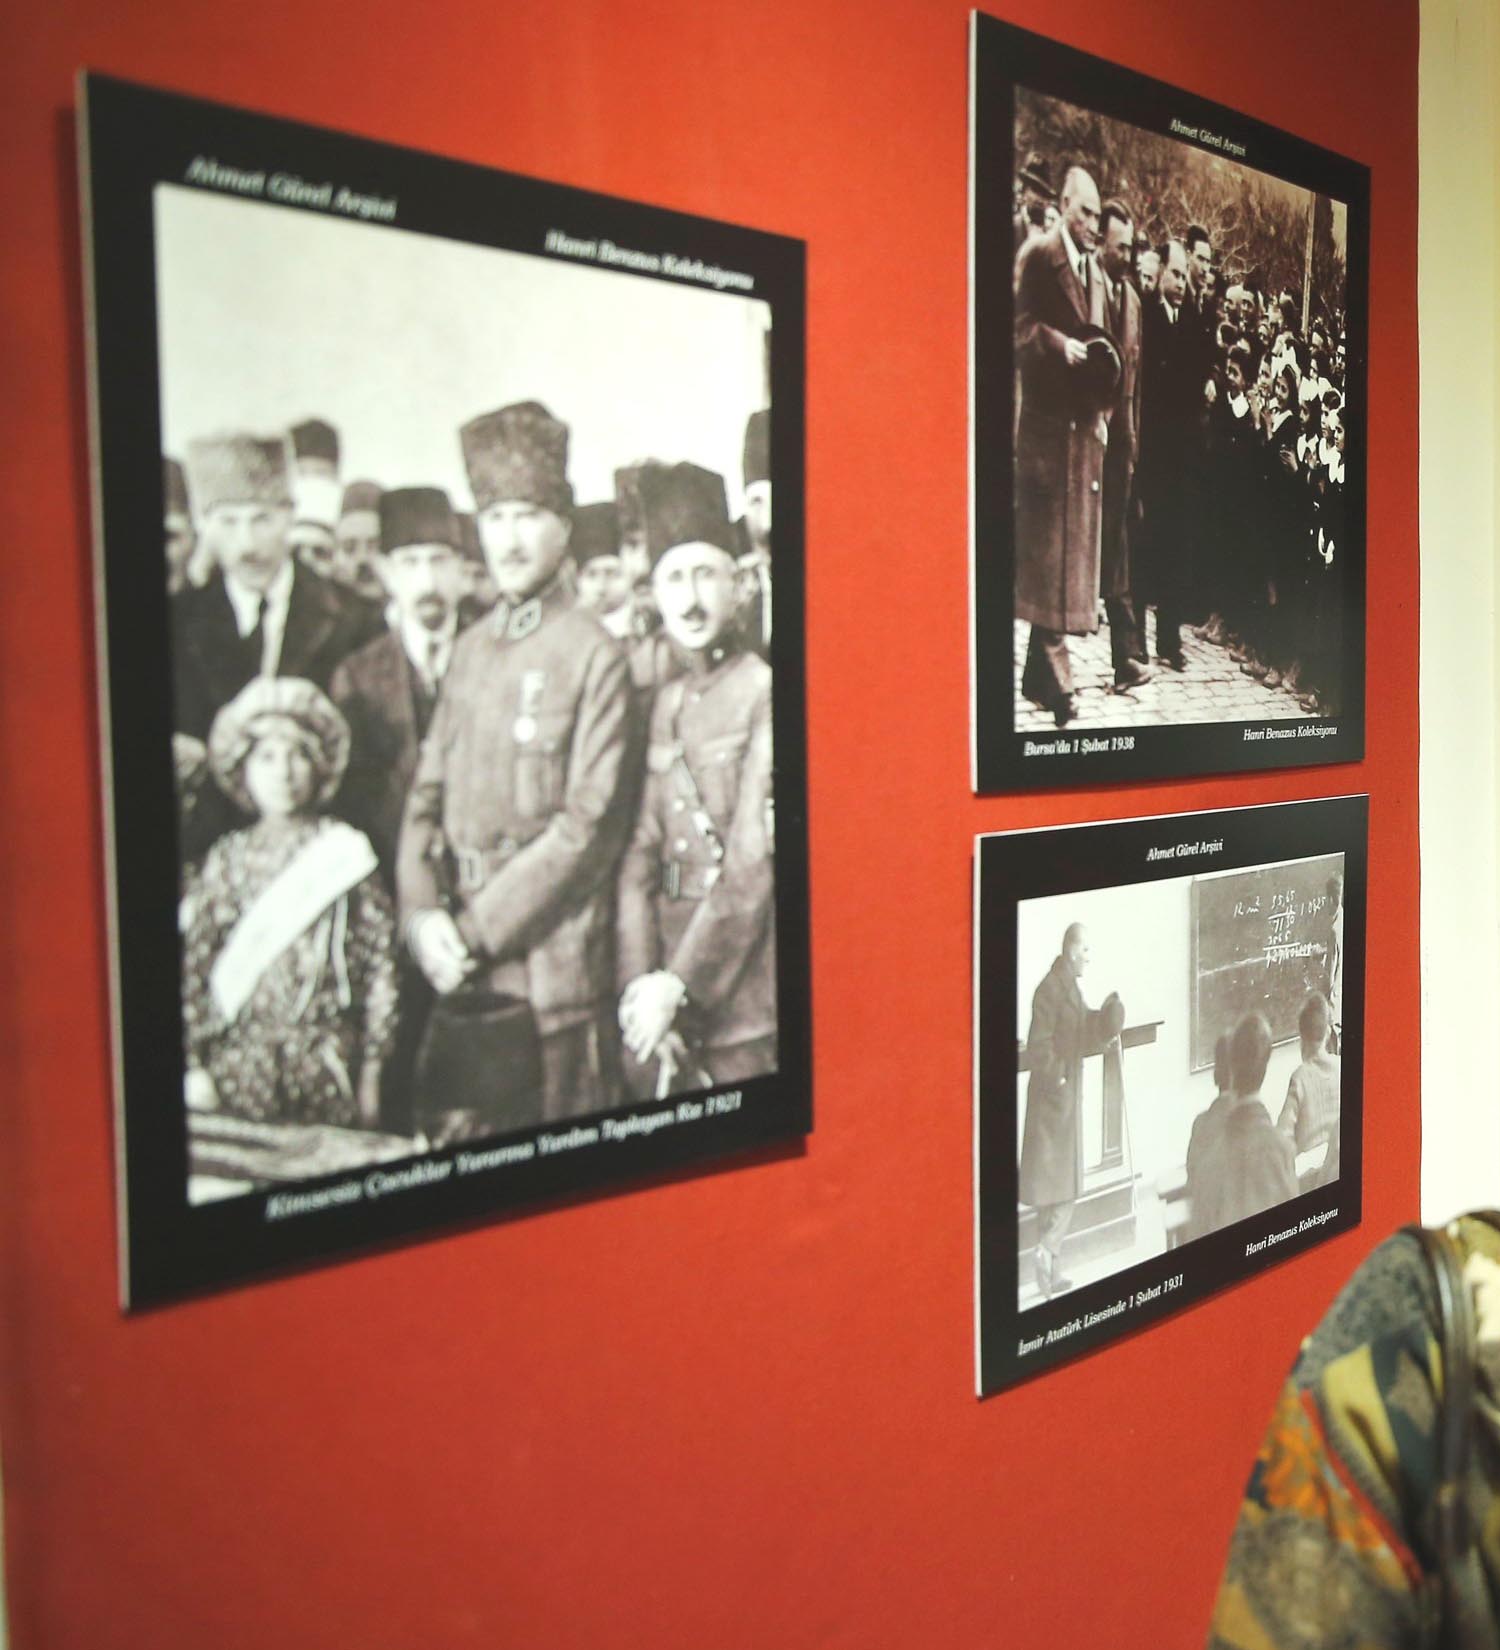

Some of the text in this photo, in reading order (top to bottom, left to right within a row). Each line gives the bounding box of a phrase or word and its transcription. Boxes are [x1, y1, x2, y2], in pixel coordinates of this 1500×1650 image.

[1170, 119, 1197, 139] Ahmet
[1200, 129, 1222, 148] Gürel
[1073, 739, 1079, 753] 1
[1081, 738, 1109, 754] Şubat
[1111, 736, 1135, 751] 1938
[1244, 724, 1338, 741] Hanri Benazus Koleksiyonu
[1146, 838, 1224, 862] Ahmet Gürel Arşivi
[705, 1091, 742, 1116] 1921
[1245, 1208, 1339, 1257] Hanri Benazus Koleksiyonu
[1017, 1273, 1184, 1357] İzmir Atatürk Lisesinde 1 Şubat 1931
